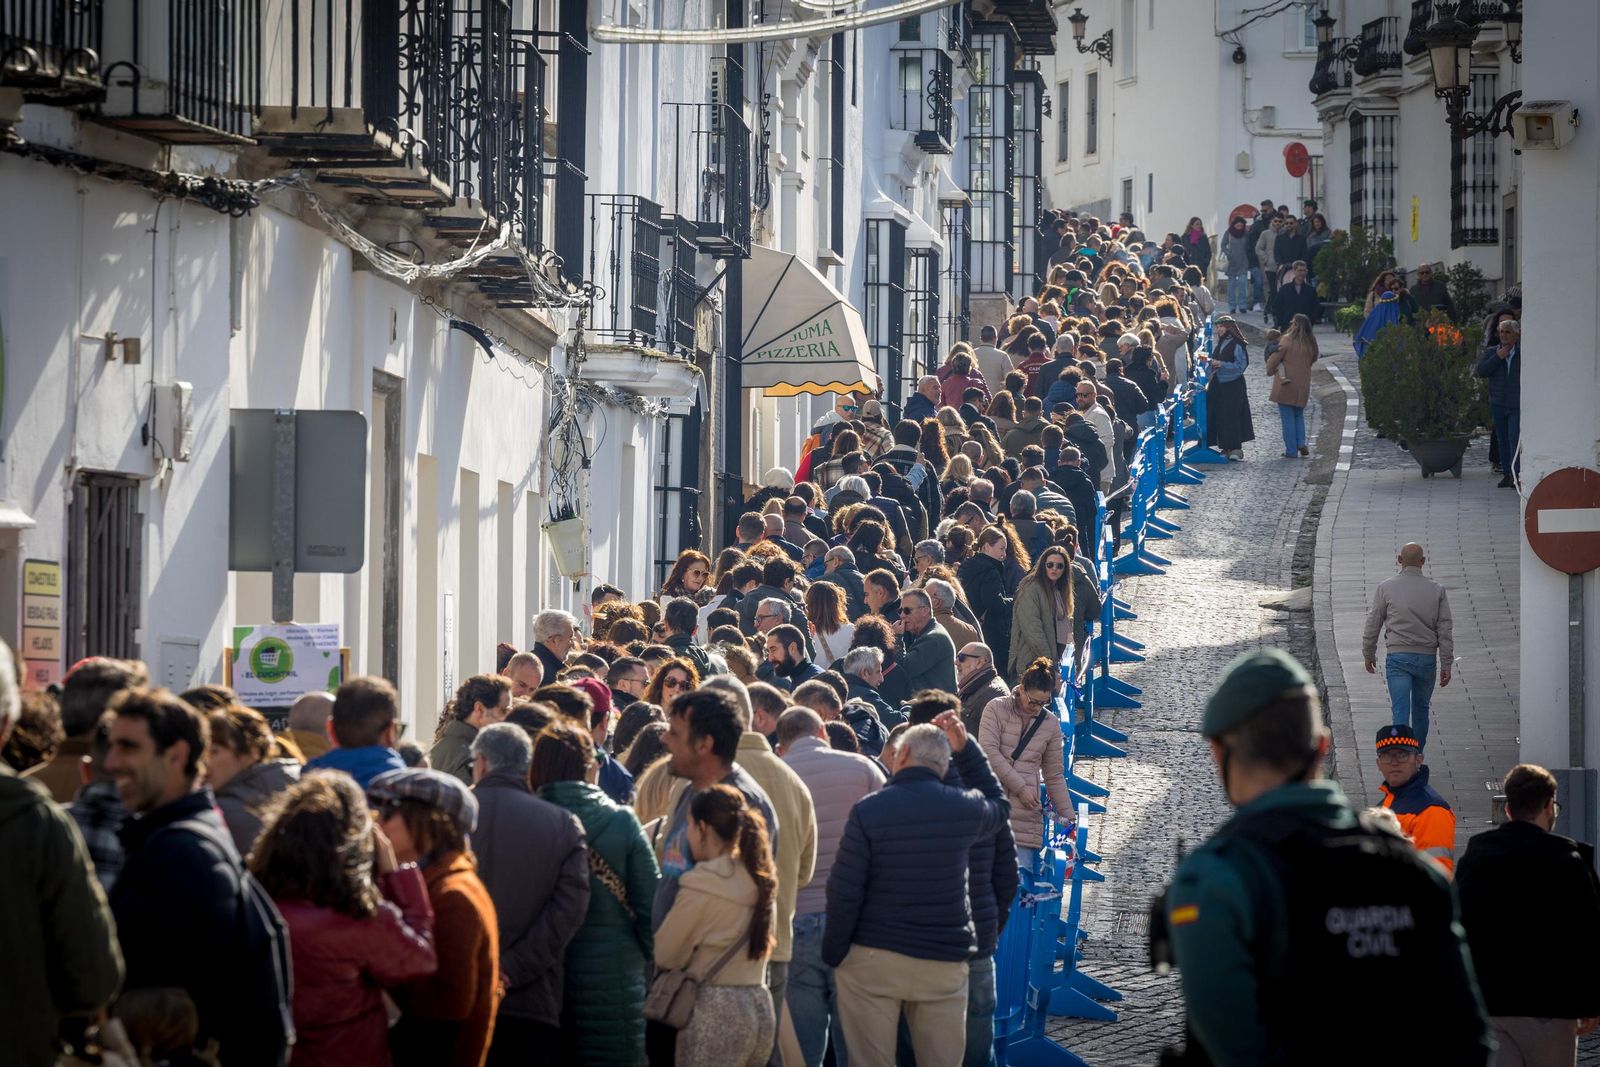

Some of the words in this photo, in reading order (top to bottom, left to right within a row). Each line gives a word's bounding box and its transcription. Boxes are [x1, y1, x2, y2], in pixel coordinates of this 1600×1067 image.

[789, 319, 833, 342] JUMA
[757, 340, 841, 358] PIZZERIA
[1325, 905, 1415, 934] GUARDIA
[1347, 932, 1400, 958] CIVIL
